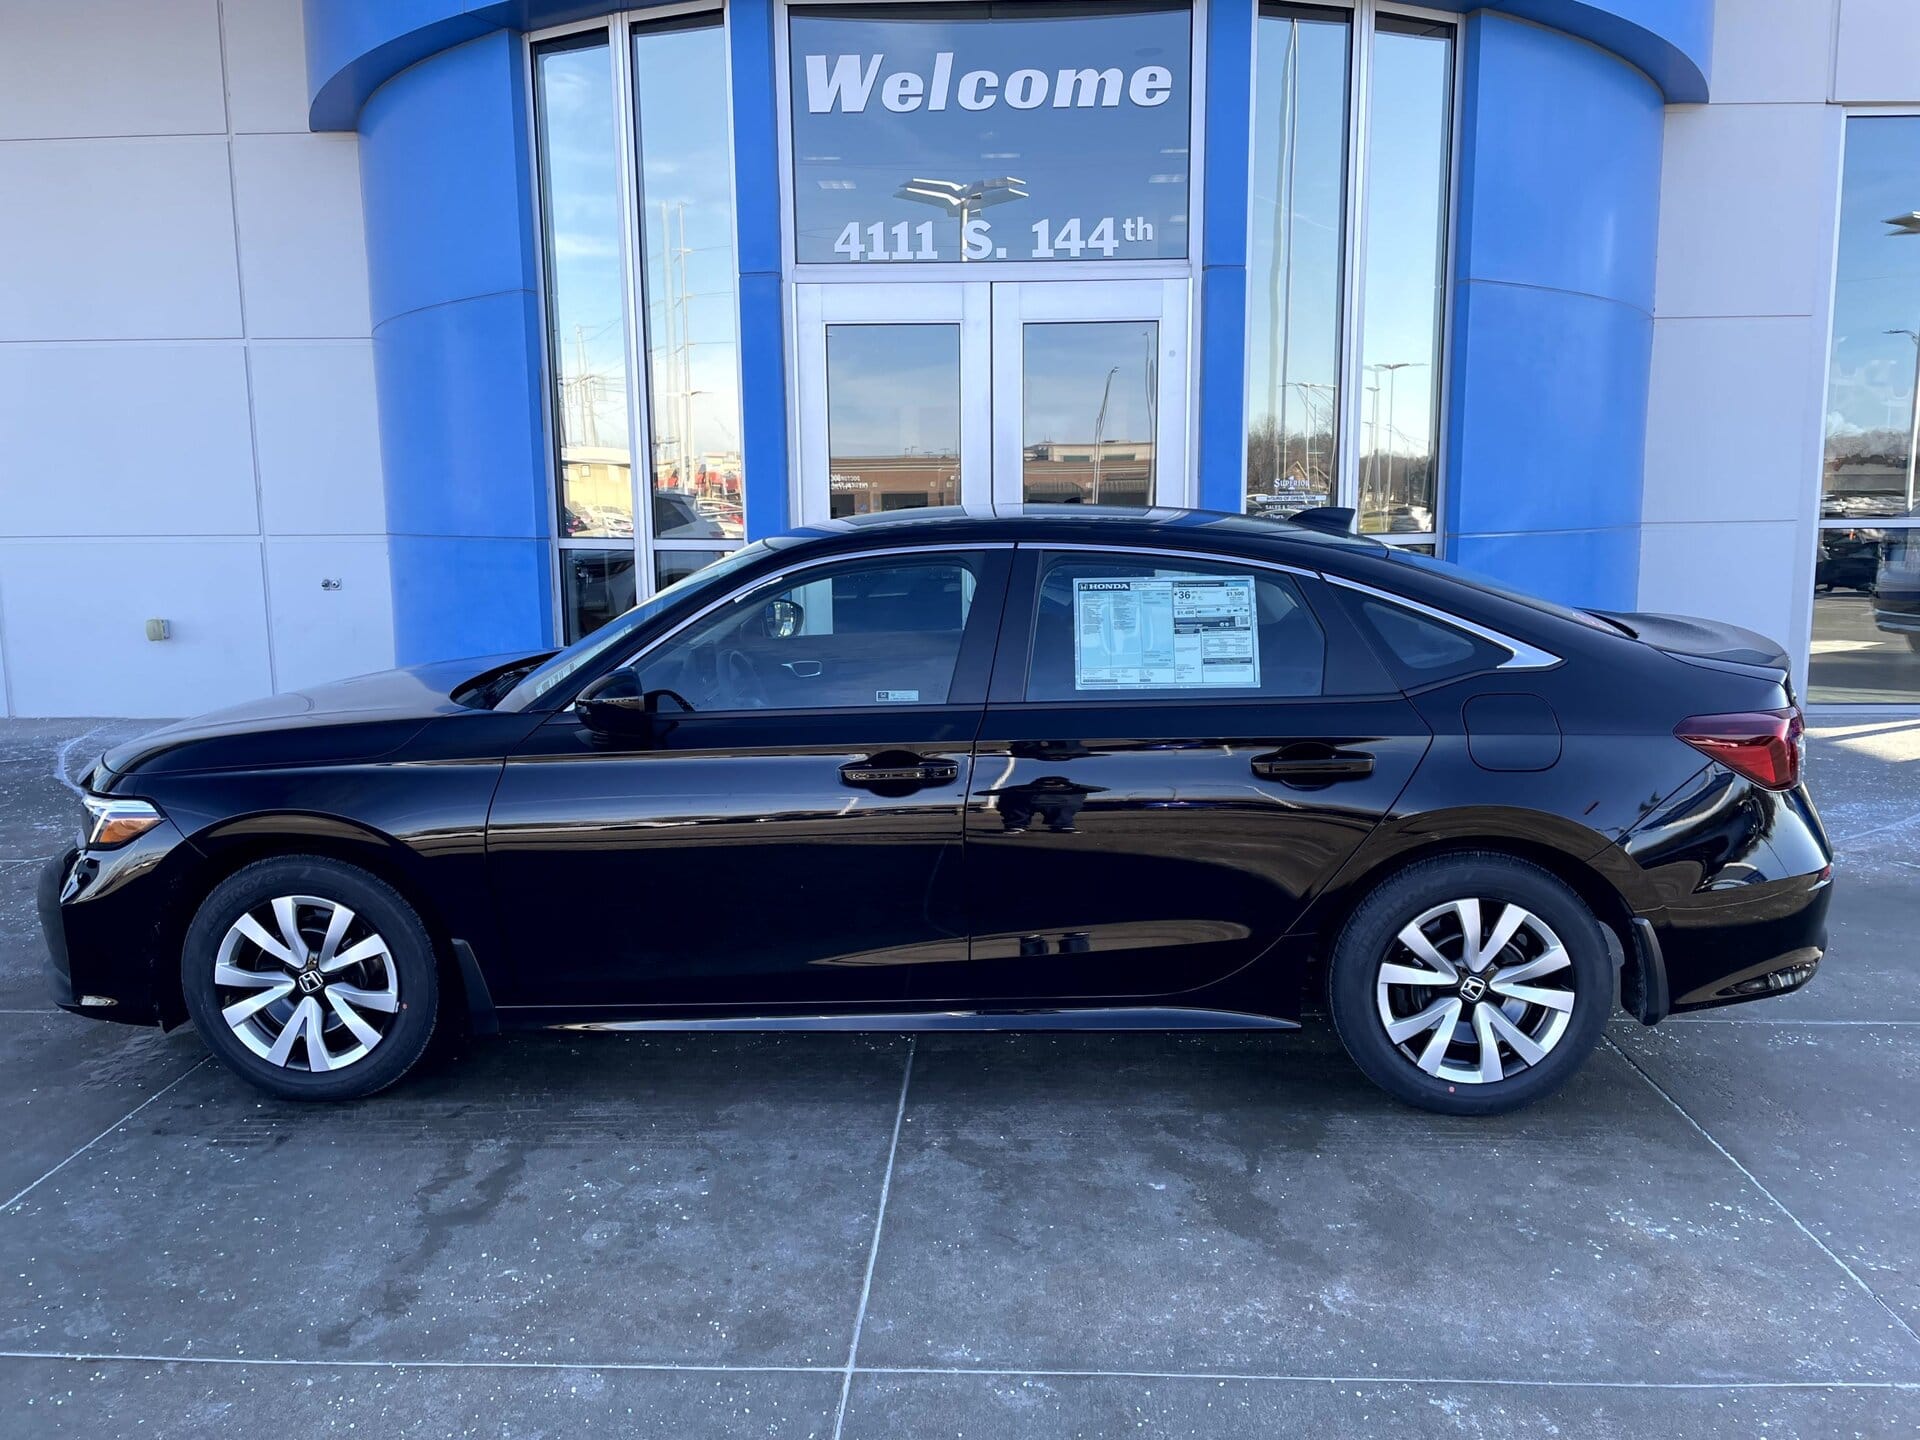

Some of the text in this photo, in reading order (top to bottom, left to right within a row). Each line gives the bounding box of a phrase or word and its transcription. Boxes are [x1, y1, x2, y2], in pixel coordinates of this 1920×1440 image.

[805, 52, 1173, 113] Welcome
[834, 216, 1154, 261] 4111 S. 144th
[1178, 590, 1191, 600] 36
